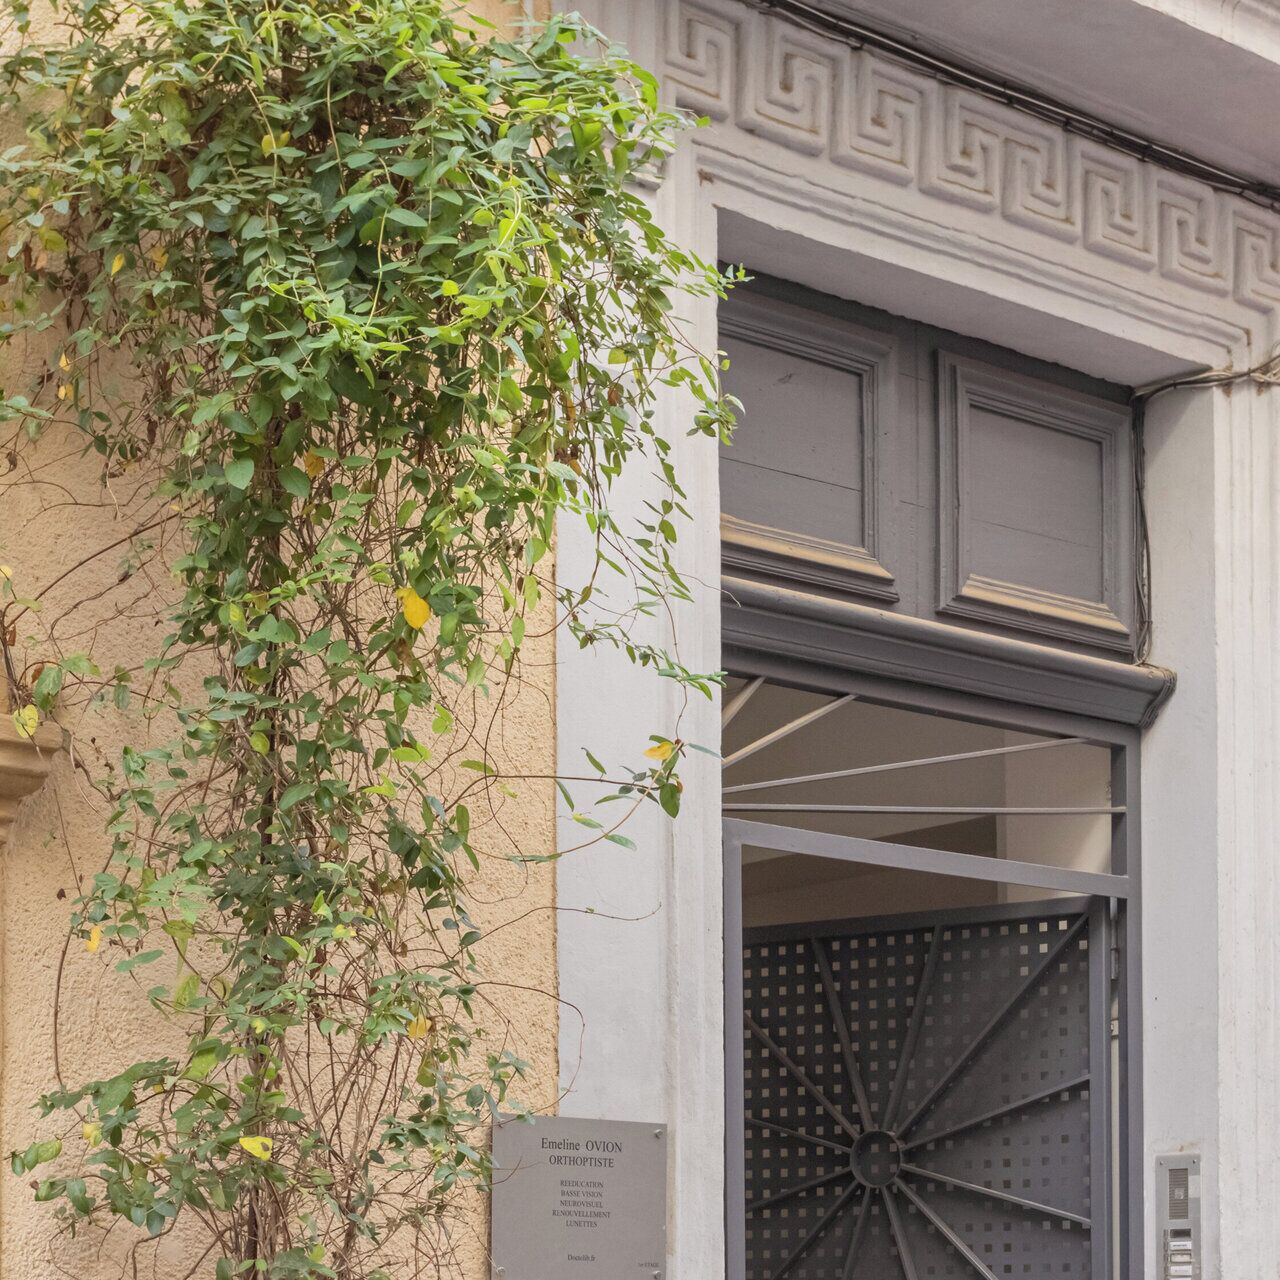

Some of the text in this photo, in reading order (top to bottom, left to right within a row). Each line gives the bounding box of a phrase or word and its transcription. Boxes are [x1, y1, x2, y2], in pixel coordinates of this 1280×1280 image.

[541, 1137, 622, 1153] Emeline OVION
[549, 1154, 615, 1168] ORTHOPTISTE
[560, 1190, 603, 1199] BASSE VISION
[559, 1200, 603, 1209] NEUROVISUEL
[552, 1209, 611, 1219] RENOUVELLEMENT
[565, 1220, 598, 1228] LUNETTES
